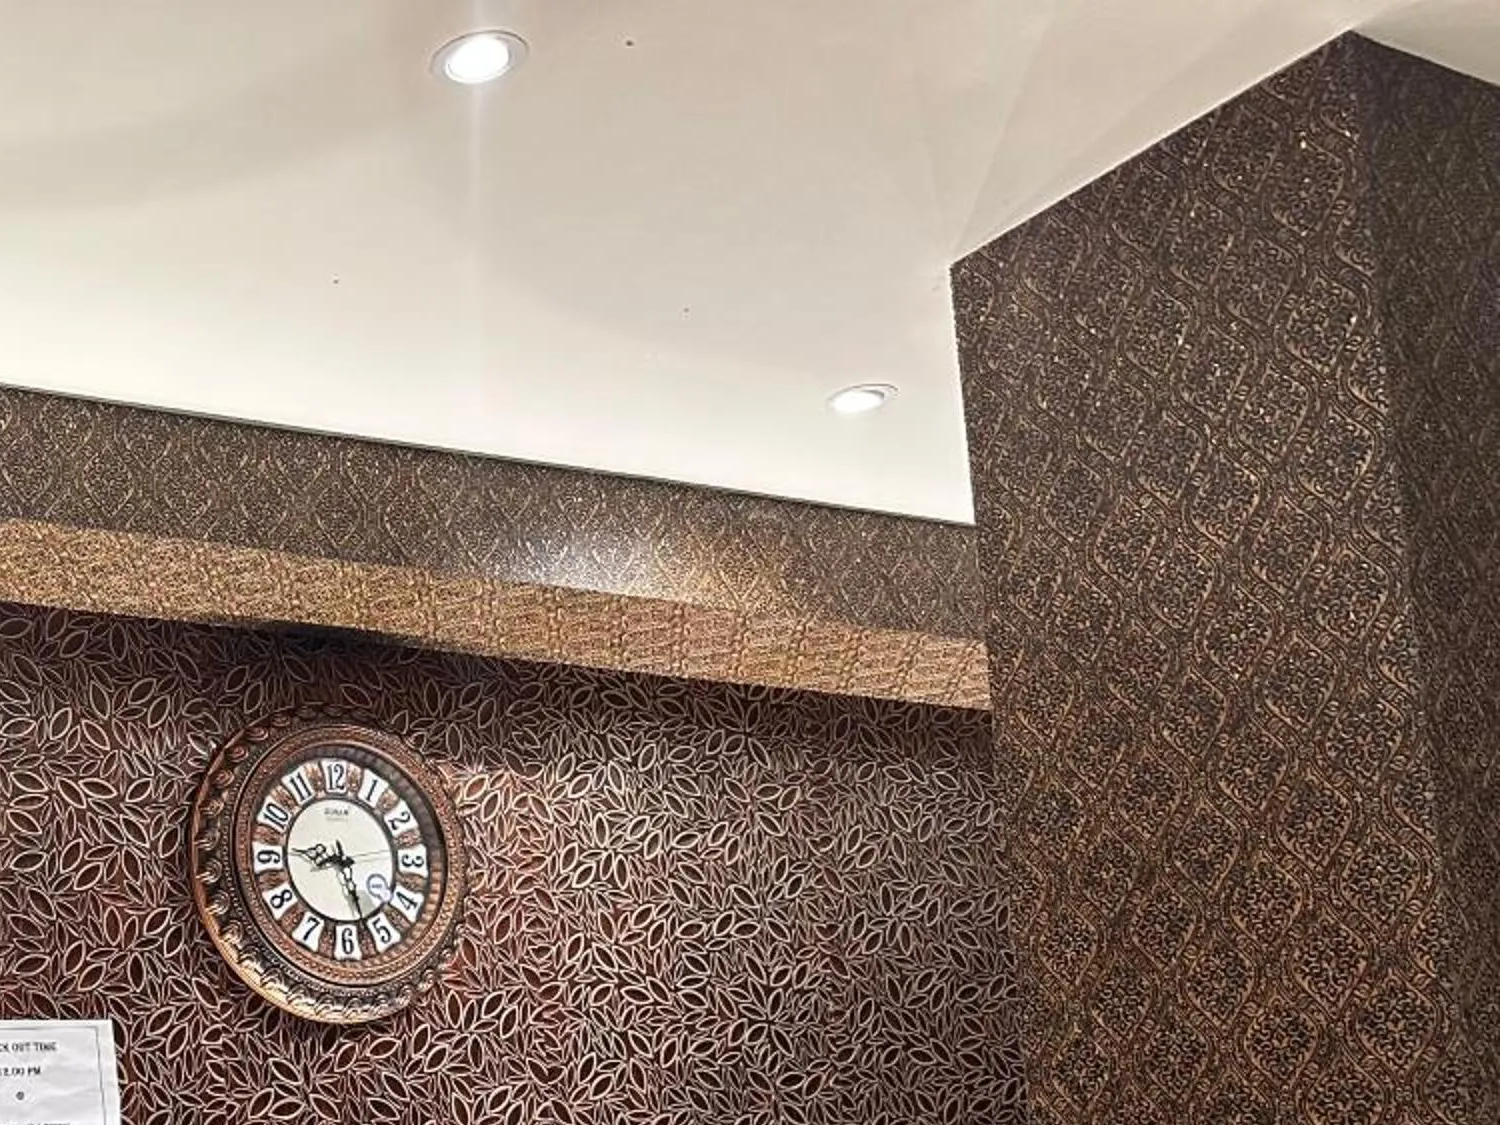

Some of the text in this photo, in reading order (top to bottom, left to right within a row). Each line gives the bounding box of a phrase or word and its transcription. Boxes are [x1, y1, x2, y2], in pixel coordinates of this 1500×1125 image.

[289, 773, 312, 800] 11
[327, 763, 346, 791] 12
[367, 779, 379, 800] 1
[263, 802, 289, 830] 10
[388, 811, 411, 830] 2
[257, 850, 281, 865] 9
[401, 854, 425, 869] 3
[270, 889, 293, 909] 8
[395, 890, 417, 911] 4
[303, 917, 320, 941] 7
[374, 919, 392, 943] 5
[341, 927, 355, 955] 6
[11, 1042, 31, 1052] OUT
[27, 1066, 41, 1076] PM
